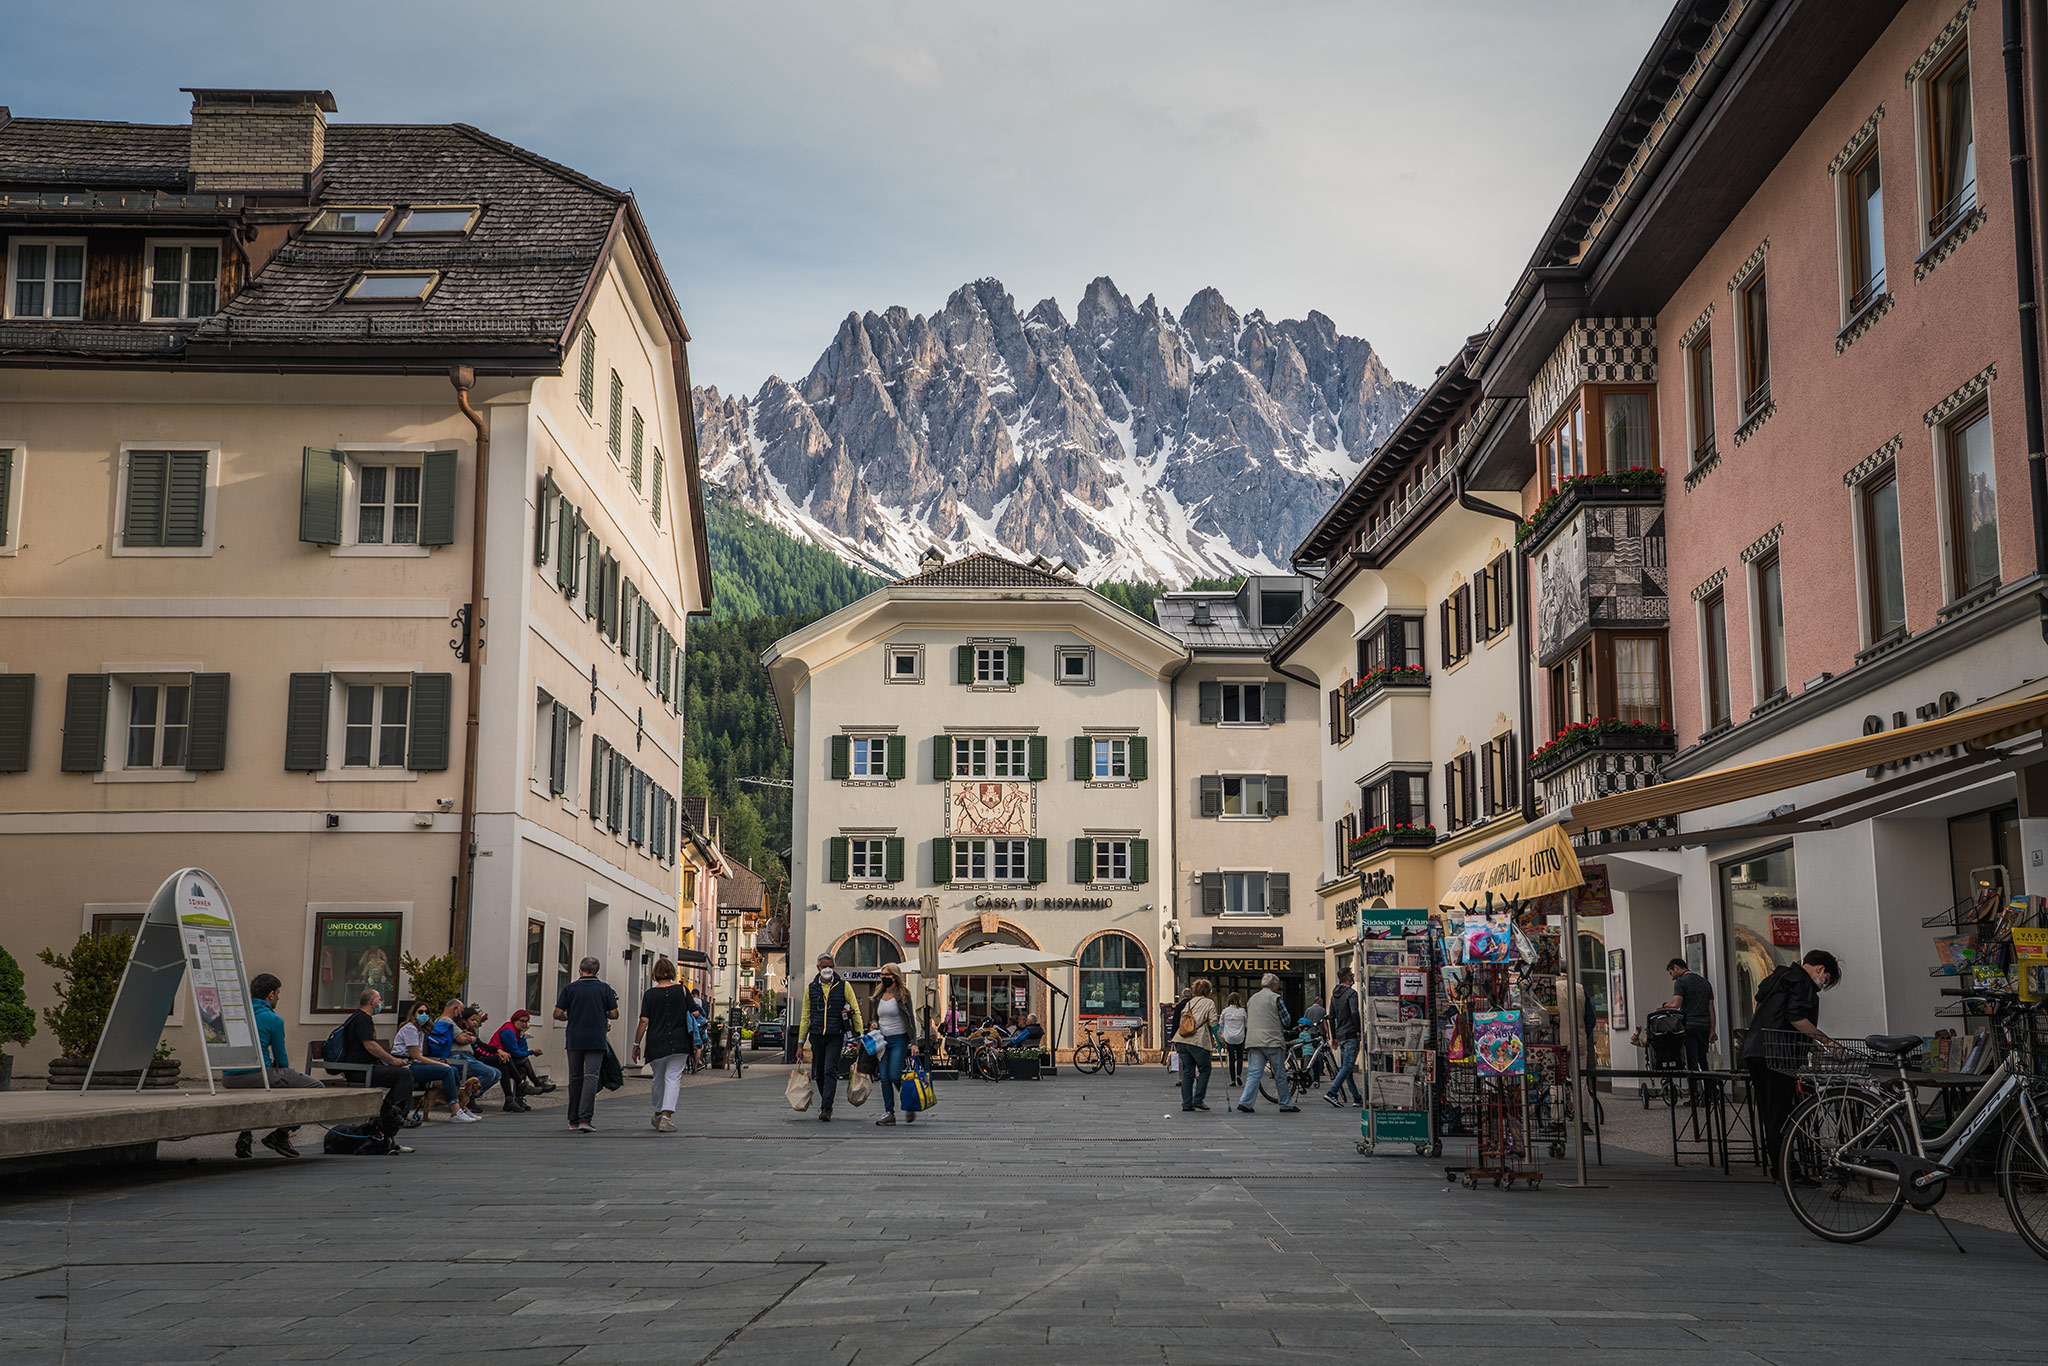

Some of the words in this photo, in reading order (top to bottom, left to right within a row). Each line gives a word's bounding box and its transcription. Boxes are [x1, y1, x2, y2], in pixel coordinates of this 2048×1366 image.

[1488, 857, 1521, 889] GIORNALI
[1529, 847, 1561, 878] LOTTO
[865, 894, 940, 908] SPARKASE
[975, 894, 1018, 908] CASSA
[1025, 897, 1037, 908] DI
[1044, 897, 1113, 909] RISPARMIO
[1362, 918, 1405, 926] Süddeutsche
[719, 920, 728, 967] BAUR
[1202, 959, 1291, 972] JUWELIER
[851, 971, 880, 979] BANCO
[1376, 1134, 1409, 1142] Süddeutsche
[1408, 1135, 1429, 1143] Zeitung
